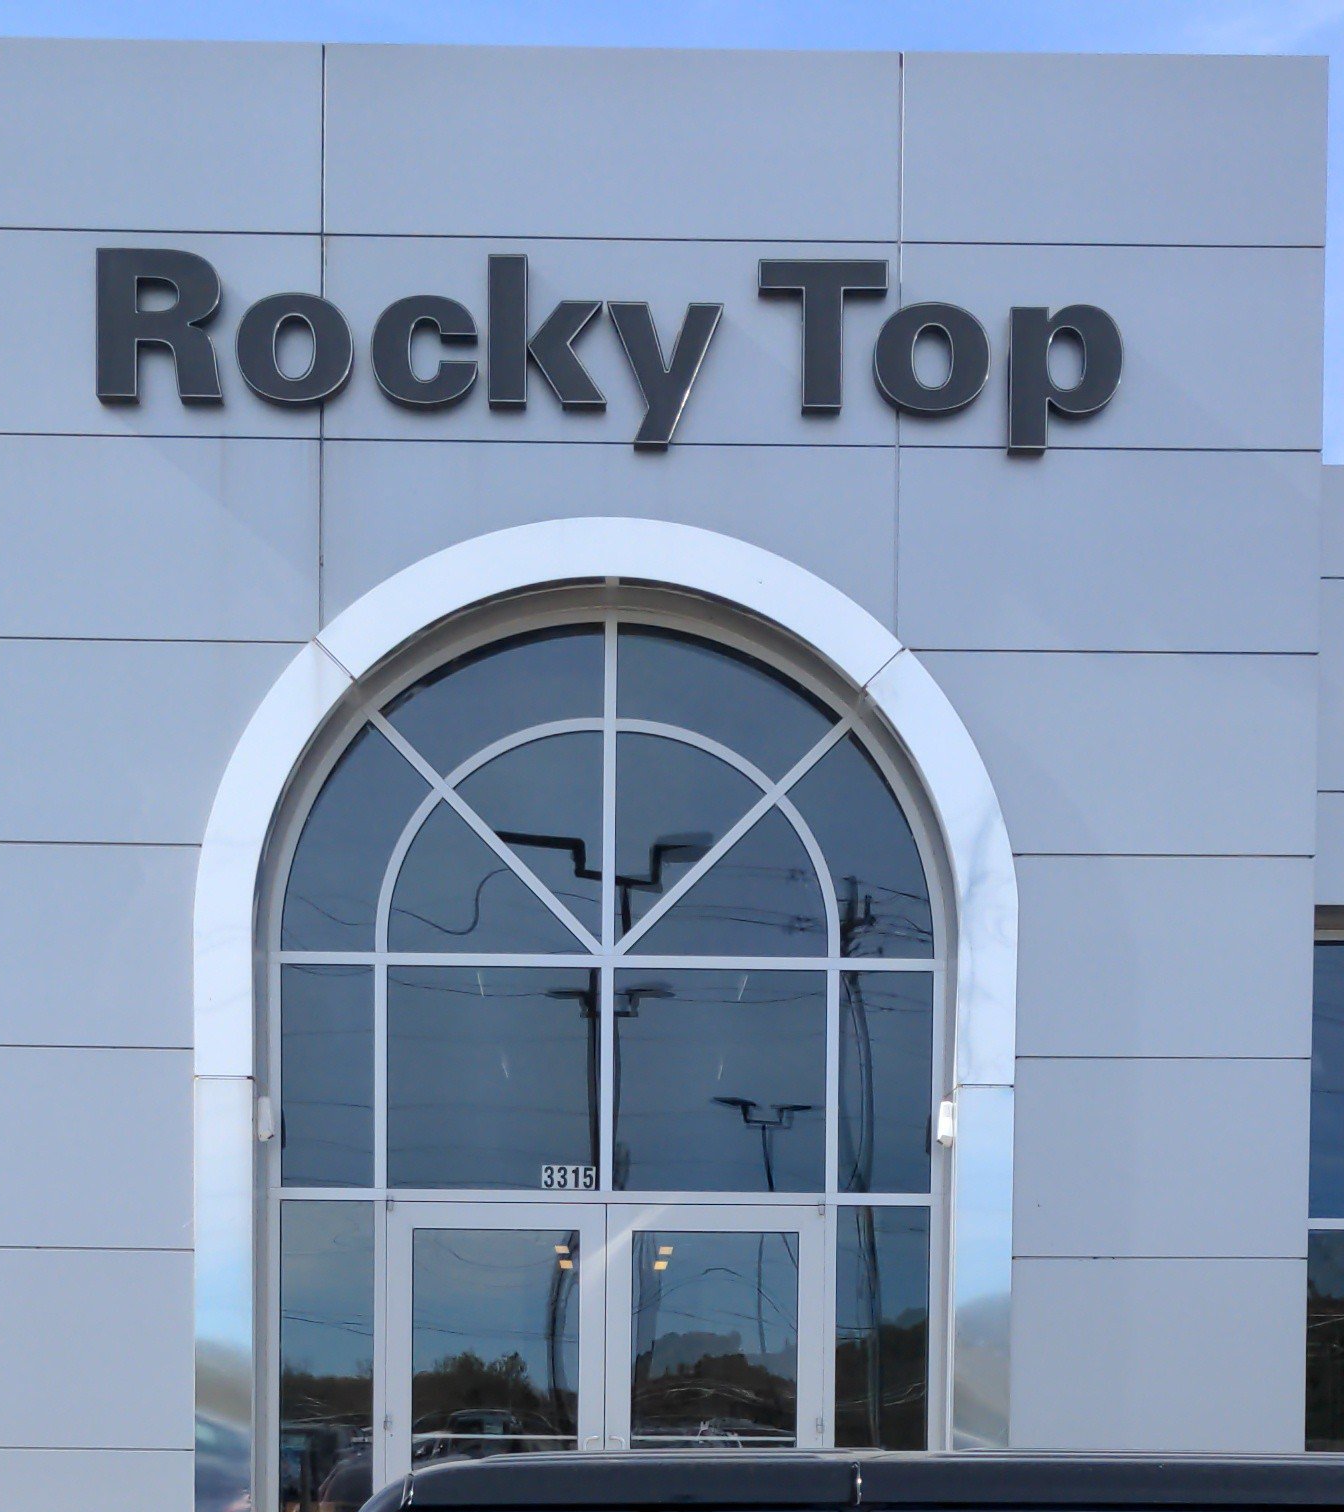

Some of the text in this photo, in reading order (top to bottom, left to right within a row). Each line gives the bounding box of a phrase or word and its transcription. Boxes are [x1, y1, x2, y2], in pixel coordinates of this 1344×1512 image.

[95, 247, 1123, 454] Rocky Top
[544, 1166, 594, 1189] 3315
